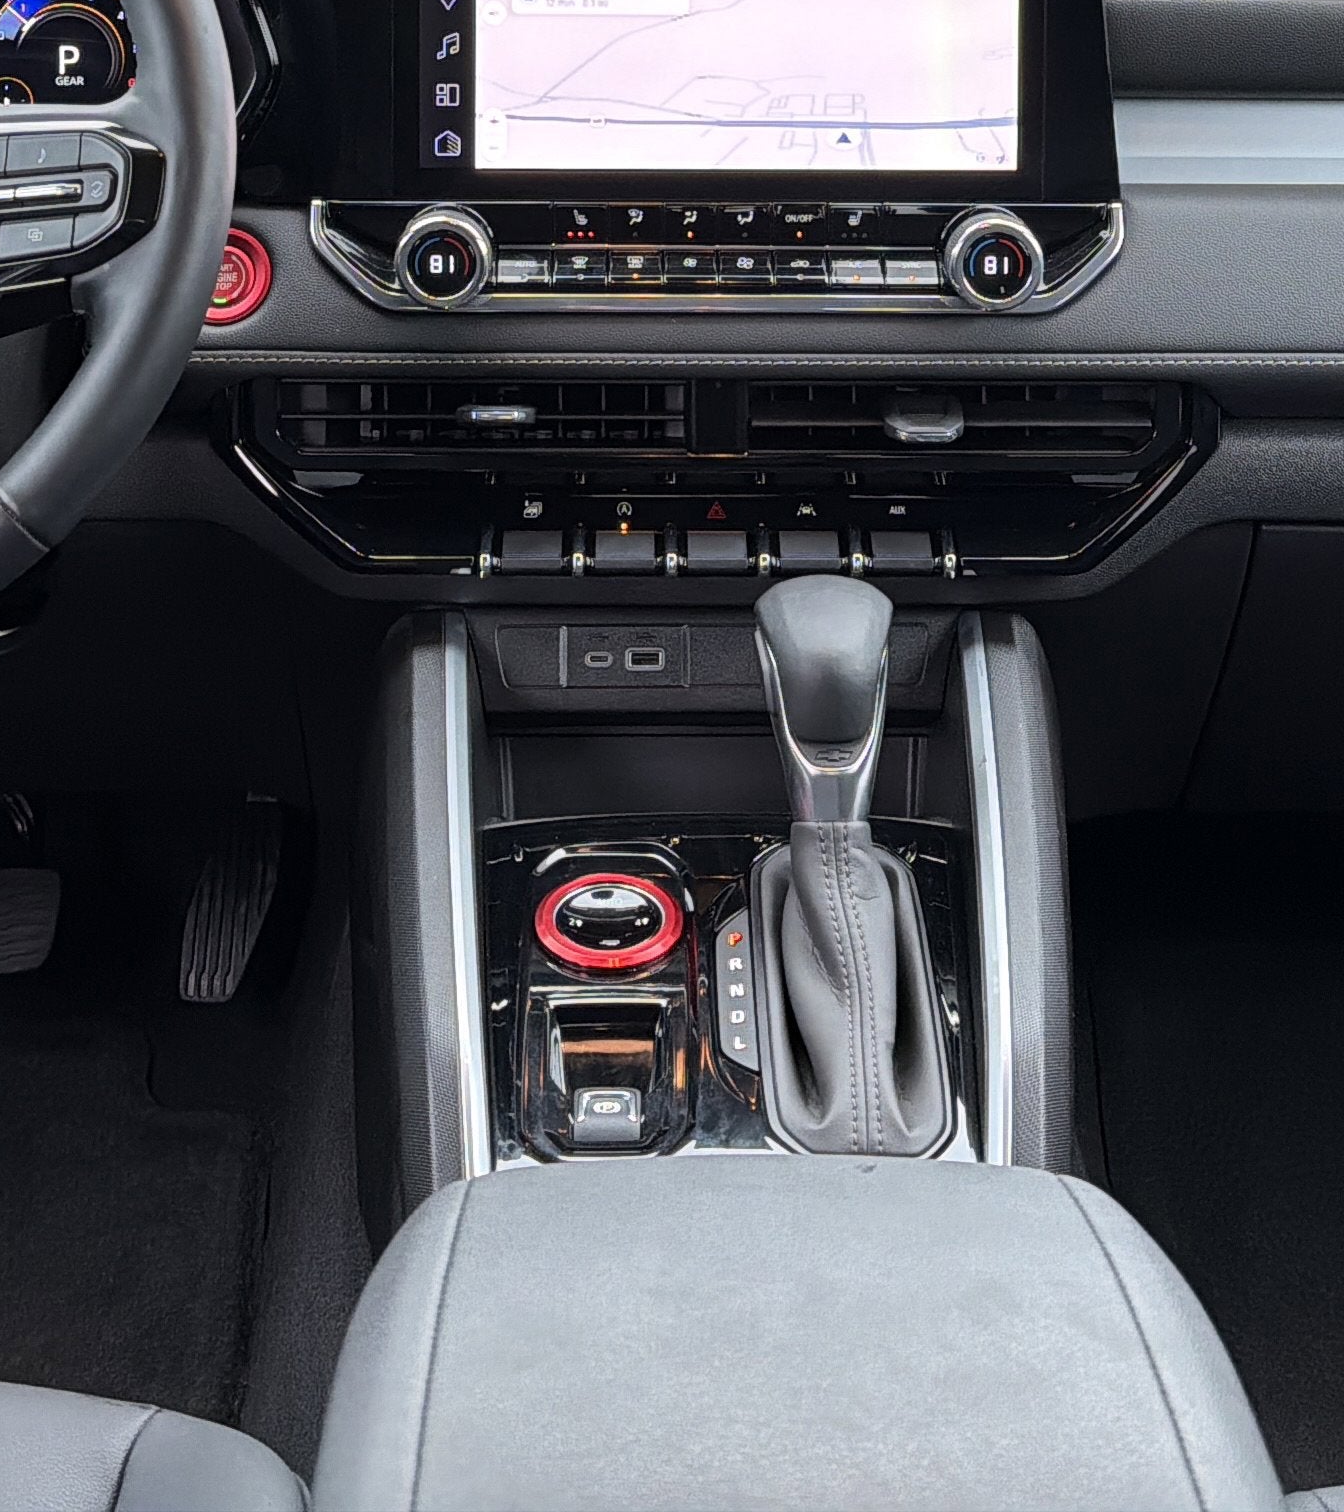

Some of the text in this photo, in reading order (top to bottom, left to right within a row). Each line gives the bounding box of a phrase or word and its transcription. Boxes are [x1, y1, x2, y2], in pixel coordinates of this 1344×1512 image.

[58, 44, 81, 76] P
[55, 75, 85, 86] GEAR
[784, 214, 814, 223] ON/OFF
[429, 254, 455, 275] 81
[983, 255, 1009, 276] 81
[216, 272, 238, 283] GINE
[888, 505, 907, 515] AUX
[727, 931, 744, 948] P
[728, 957, 744, 971] R
[729, 983, 745, 998] N
[730, 1010, 746, 1024] D
[733, 1036, 747, 1050] L
